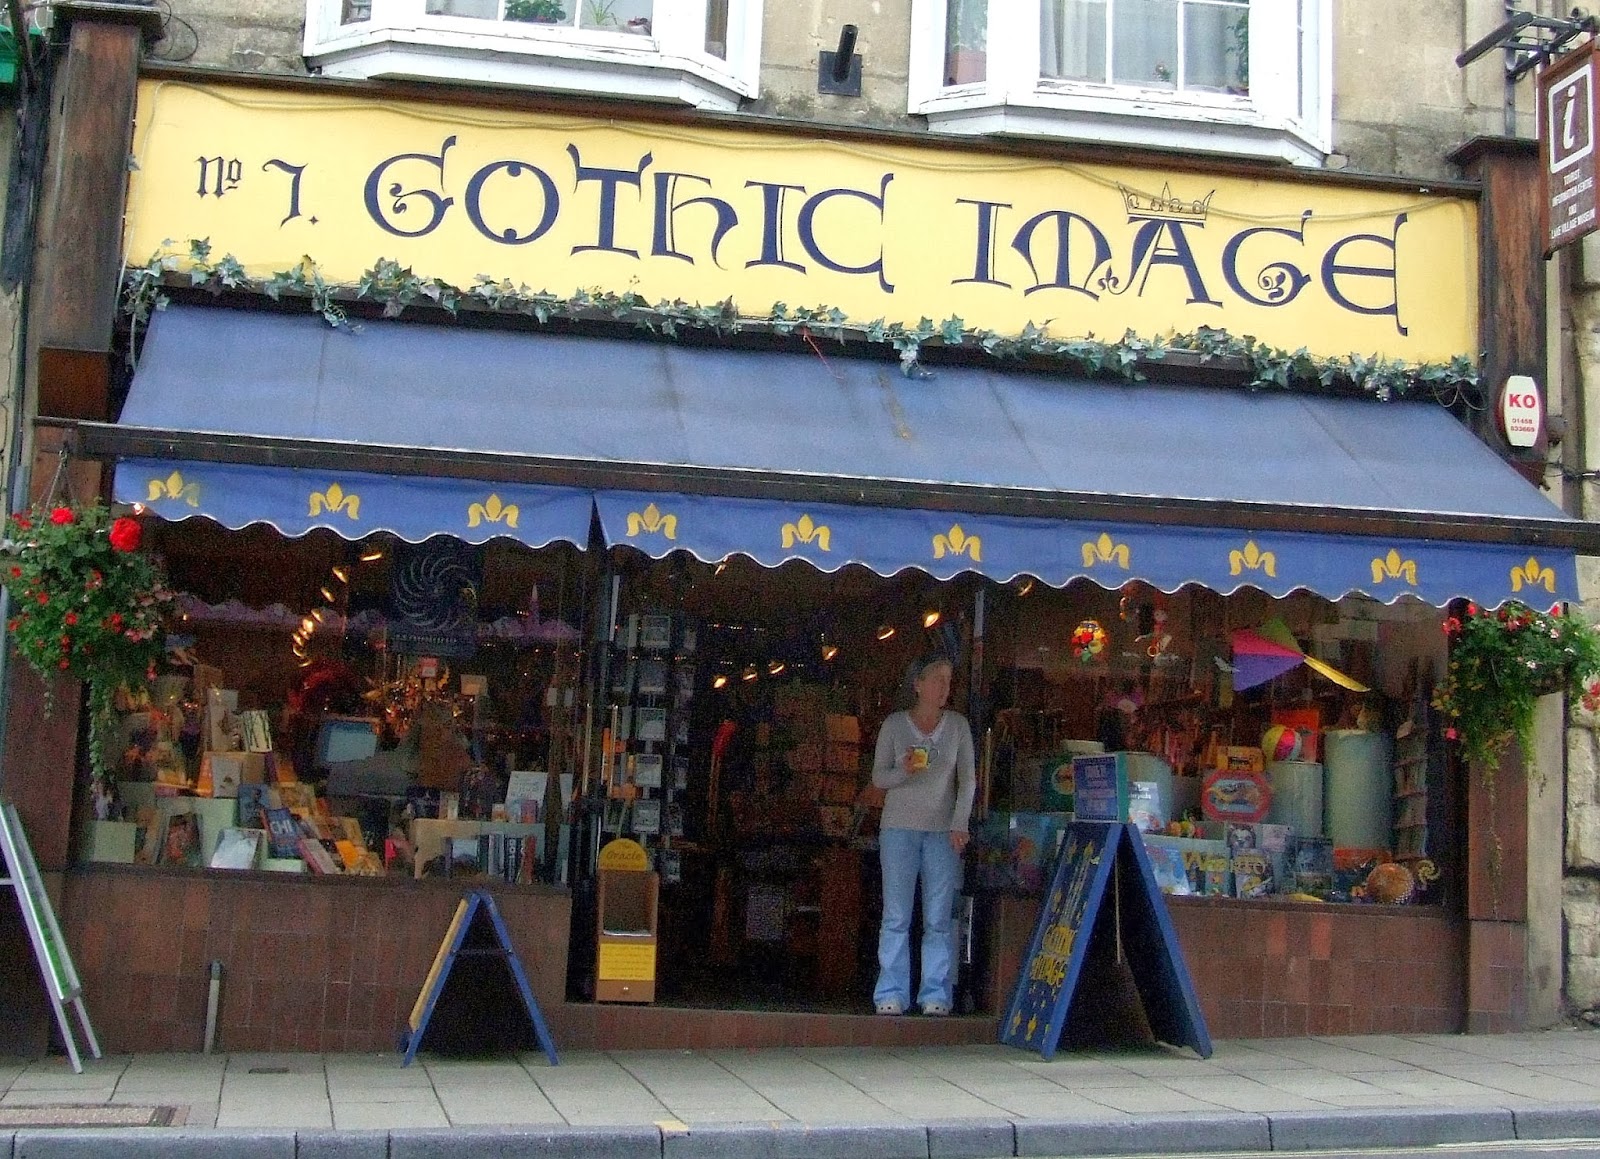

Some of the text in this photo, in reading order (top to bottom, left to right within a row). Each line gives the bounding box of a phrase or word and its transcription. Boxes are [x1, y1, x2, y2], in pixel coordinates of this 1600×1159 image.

[363, 135, 894, 295] GOTHIC
[951, 197, 1409, 337] IMAGE
[1508, 393, 1536, 409] KO
